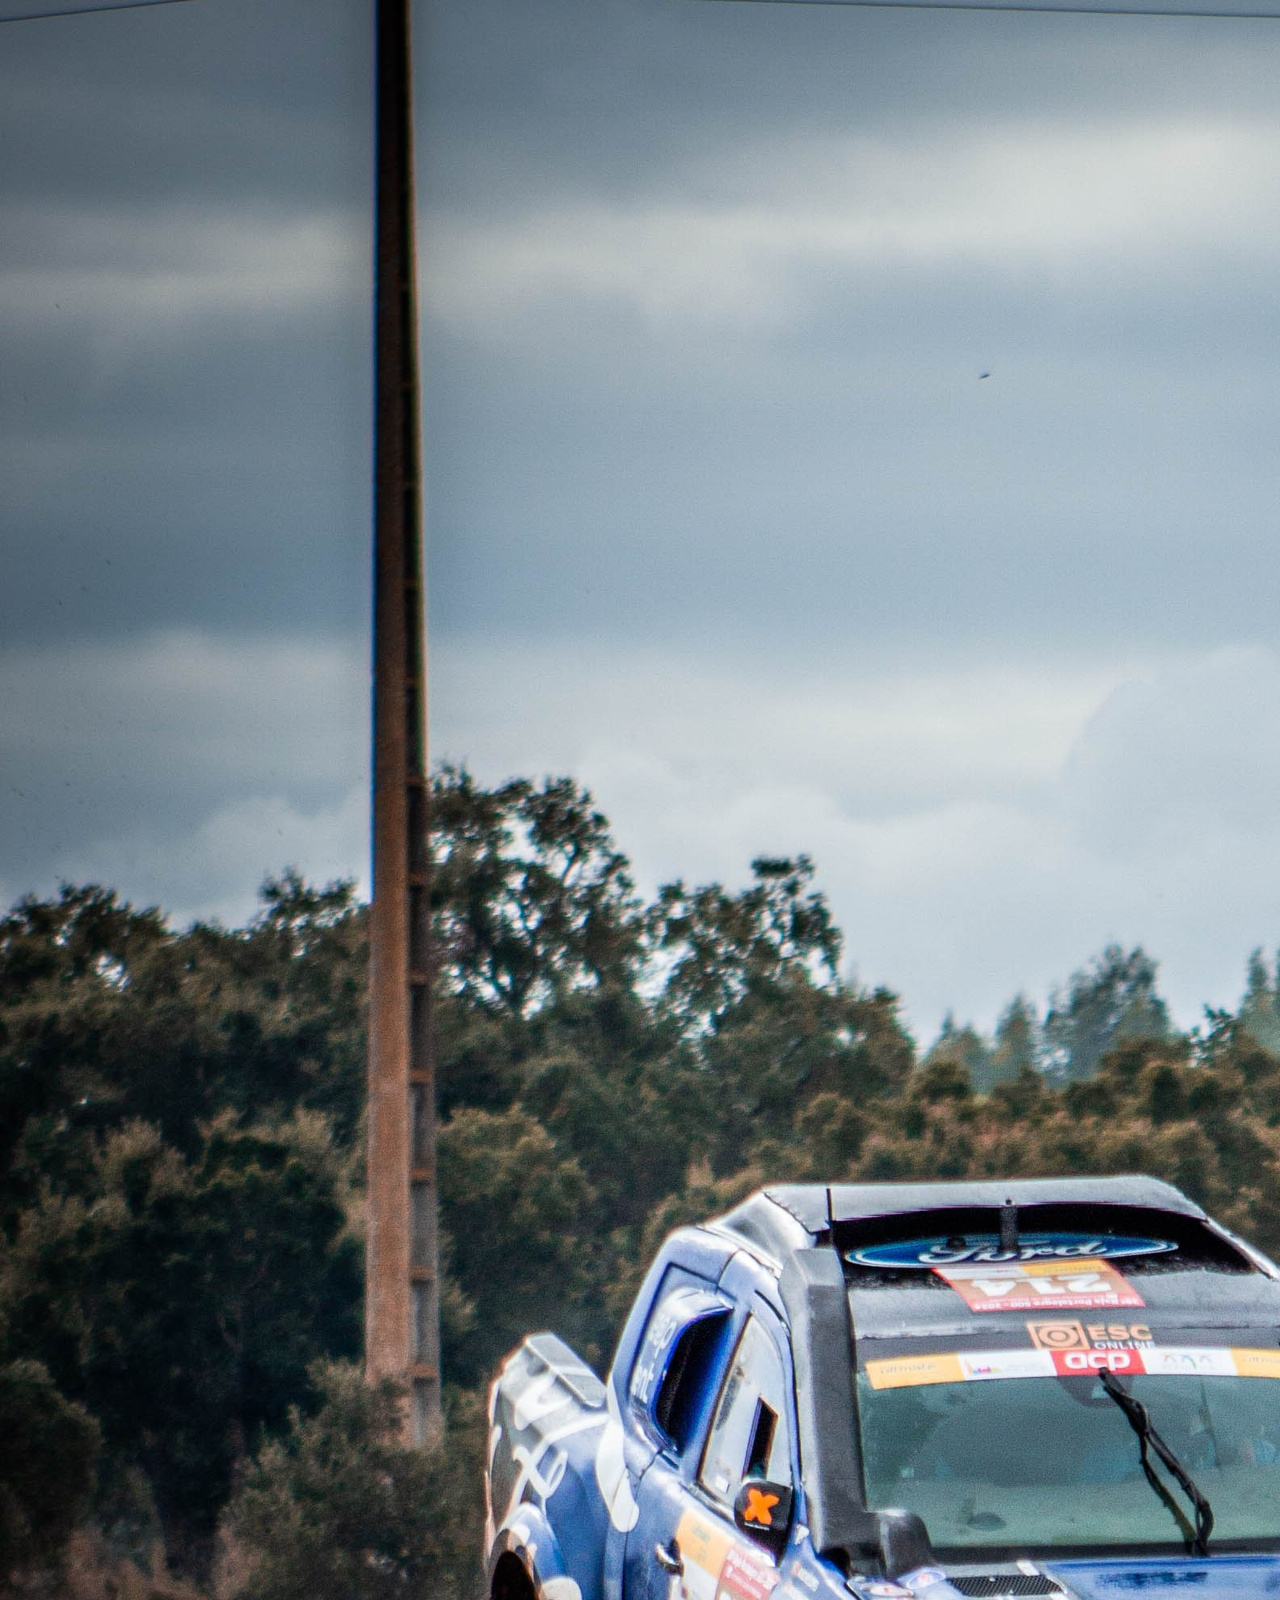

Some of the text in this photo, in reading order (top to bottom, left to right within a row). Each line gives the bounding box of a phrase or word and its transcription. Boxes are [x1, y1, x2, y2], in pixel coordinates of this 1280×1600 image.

[970, 1273, 1112, 1297] 214
[1086, 1324, 1153, 1341] ESC
[1093, 1340, 1156, 1351] ONLINE
[1064, 1350, 1131, 1371] acp
